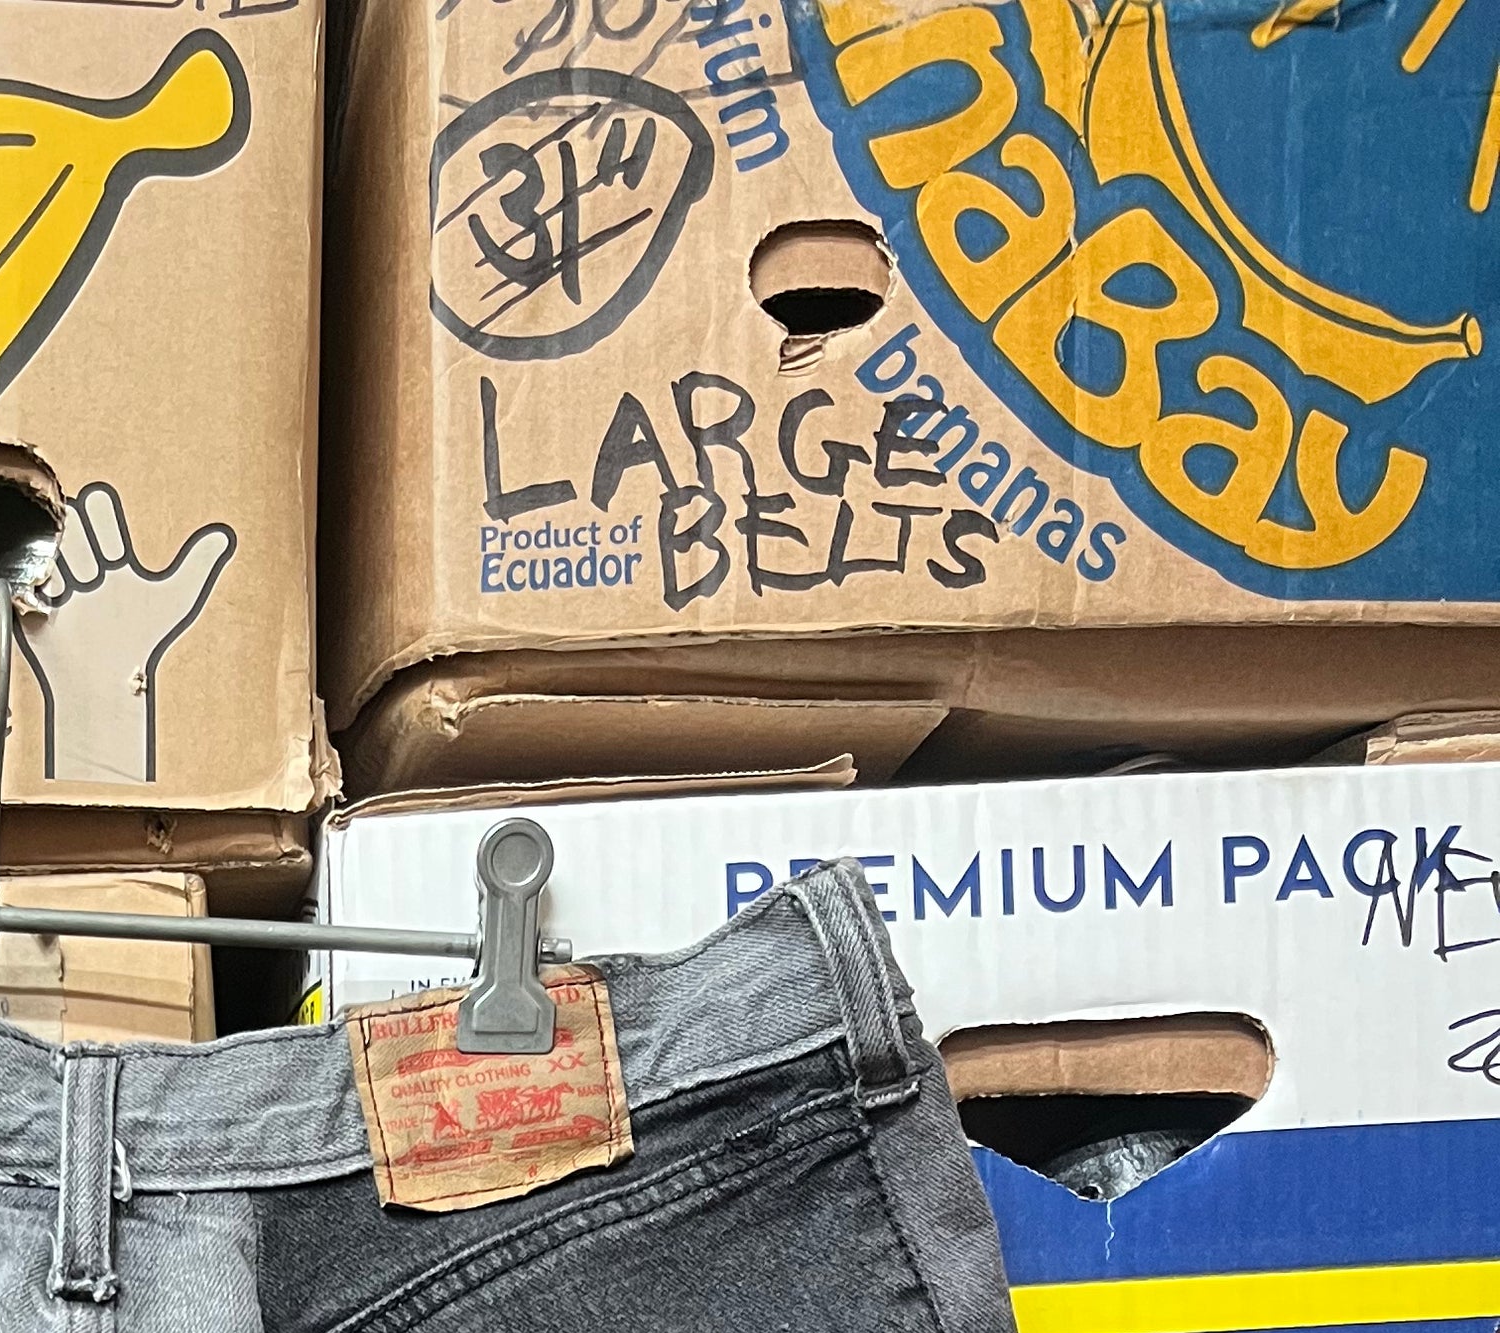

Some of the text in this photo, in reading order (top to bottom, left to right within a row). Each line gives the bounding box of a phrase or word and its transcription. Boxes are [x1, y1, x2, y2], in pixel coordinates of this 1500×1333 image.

[480, 370, 949, 523] LARGE
[853, 322, 1128, 583] bananas
[479, 513, 643, 552] Product of
[480, 545, 643, 594] Ecuador
[656, 484, 1001, 612] BELTS
[726, 826, 1462, 922] PEMIUM PACK
[455, 1063, 531, 1088] CLOTHING
